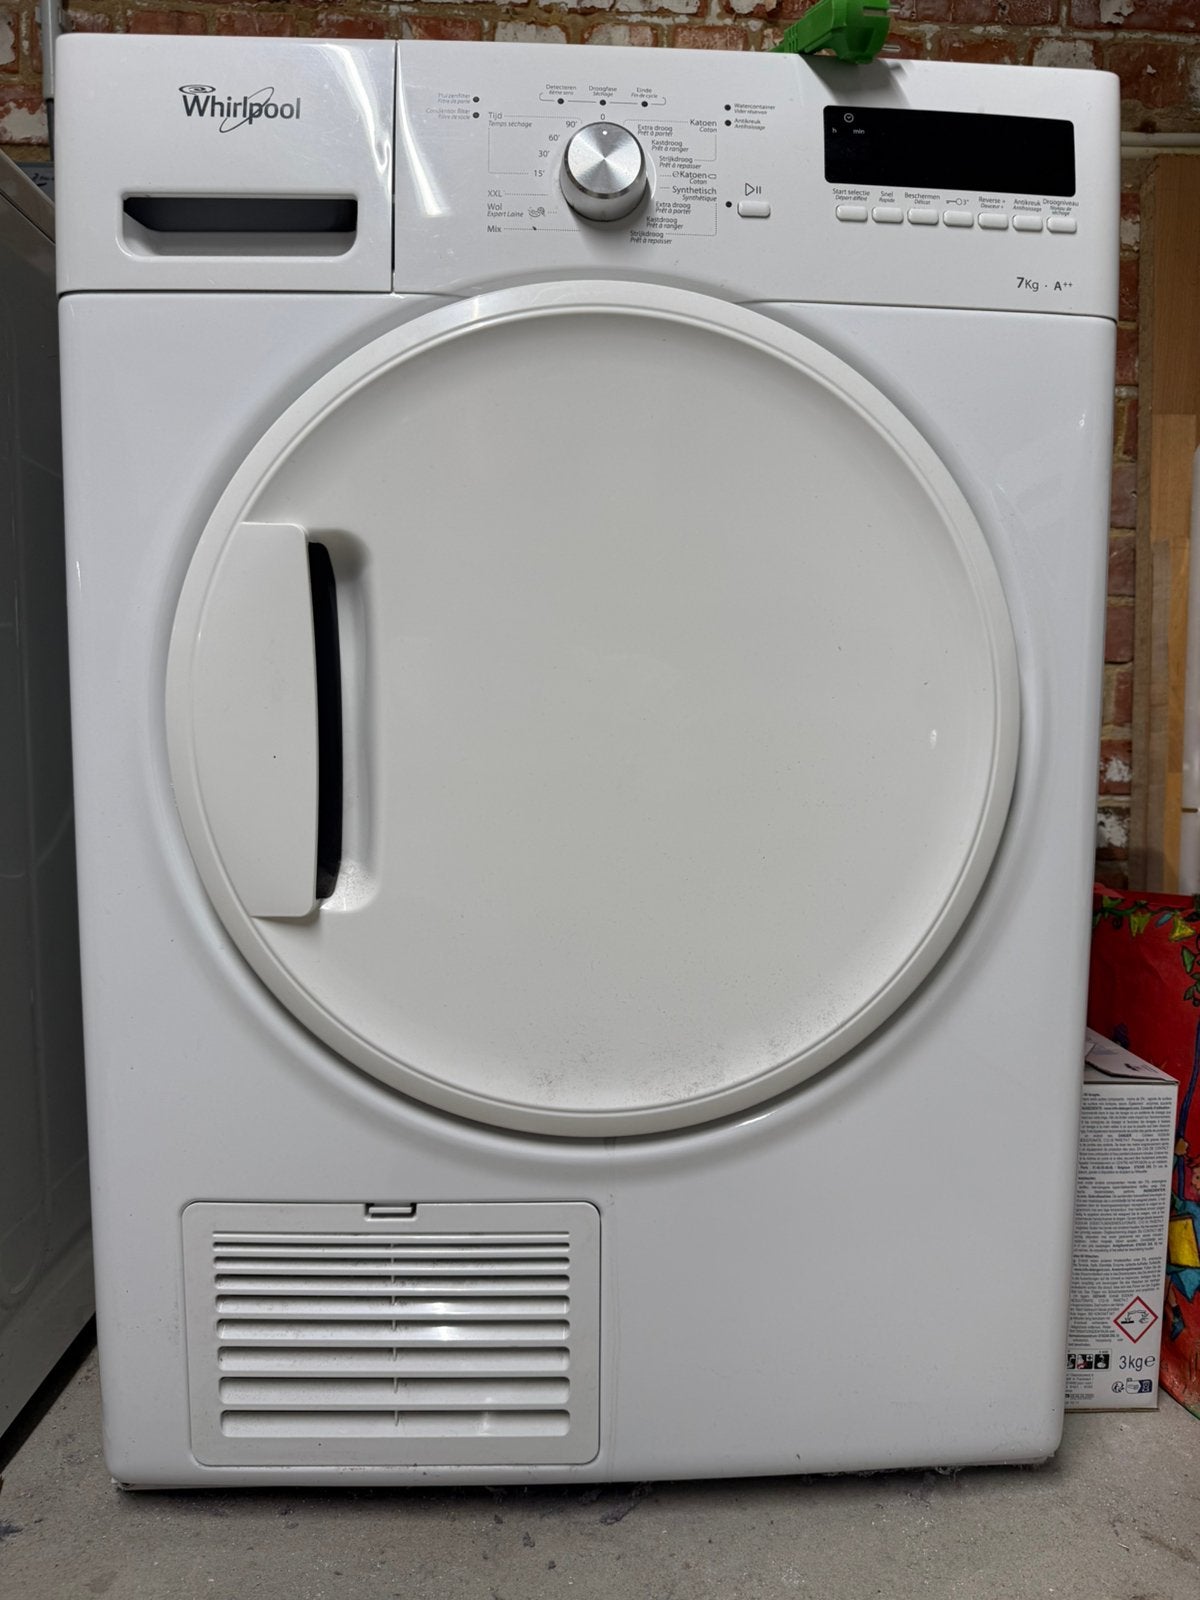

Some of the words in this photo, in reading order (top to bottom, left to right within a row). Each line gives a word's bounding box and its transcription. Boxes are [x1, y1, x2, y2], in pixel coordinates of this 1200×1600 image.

[183, 94, 300, 125] Whirlpool
[488, 112, 503, 121] Tijd
[690, 119, 717, 127] Katoen
[654, 125, 672, 133] droog
[651, 139, 682, 147] Kastdroog
[659, 155, 693, 164] Strijkdroog
[680, 170, 707, 179] Katoen
[487, 190, 502, 198] XXL
[672, 186, 717, 195] Synthetisch
[904, 192, 940, 200] Beschermen
[978, 196, 1000, 204] Reverse
[672, 202, 691, 210] droog
[1042, 198, 1079, 207] Droogniveau
[487, 203, 502, 211] Wol
[646, 216, 678, 224] Kastdroog
[630, 230, 664, 238] Strijkdroog
[1016, 276, 1039, 292] 7Kg
[1054, 280, 1073, 291] A++
